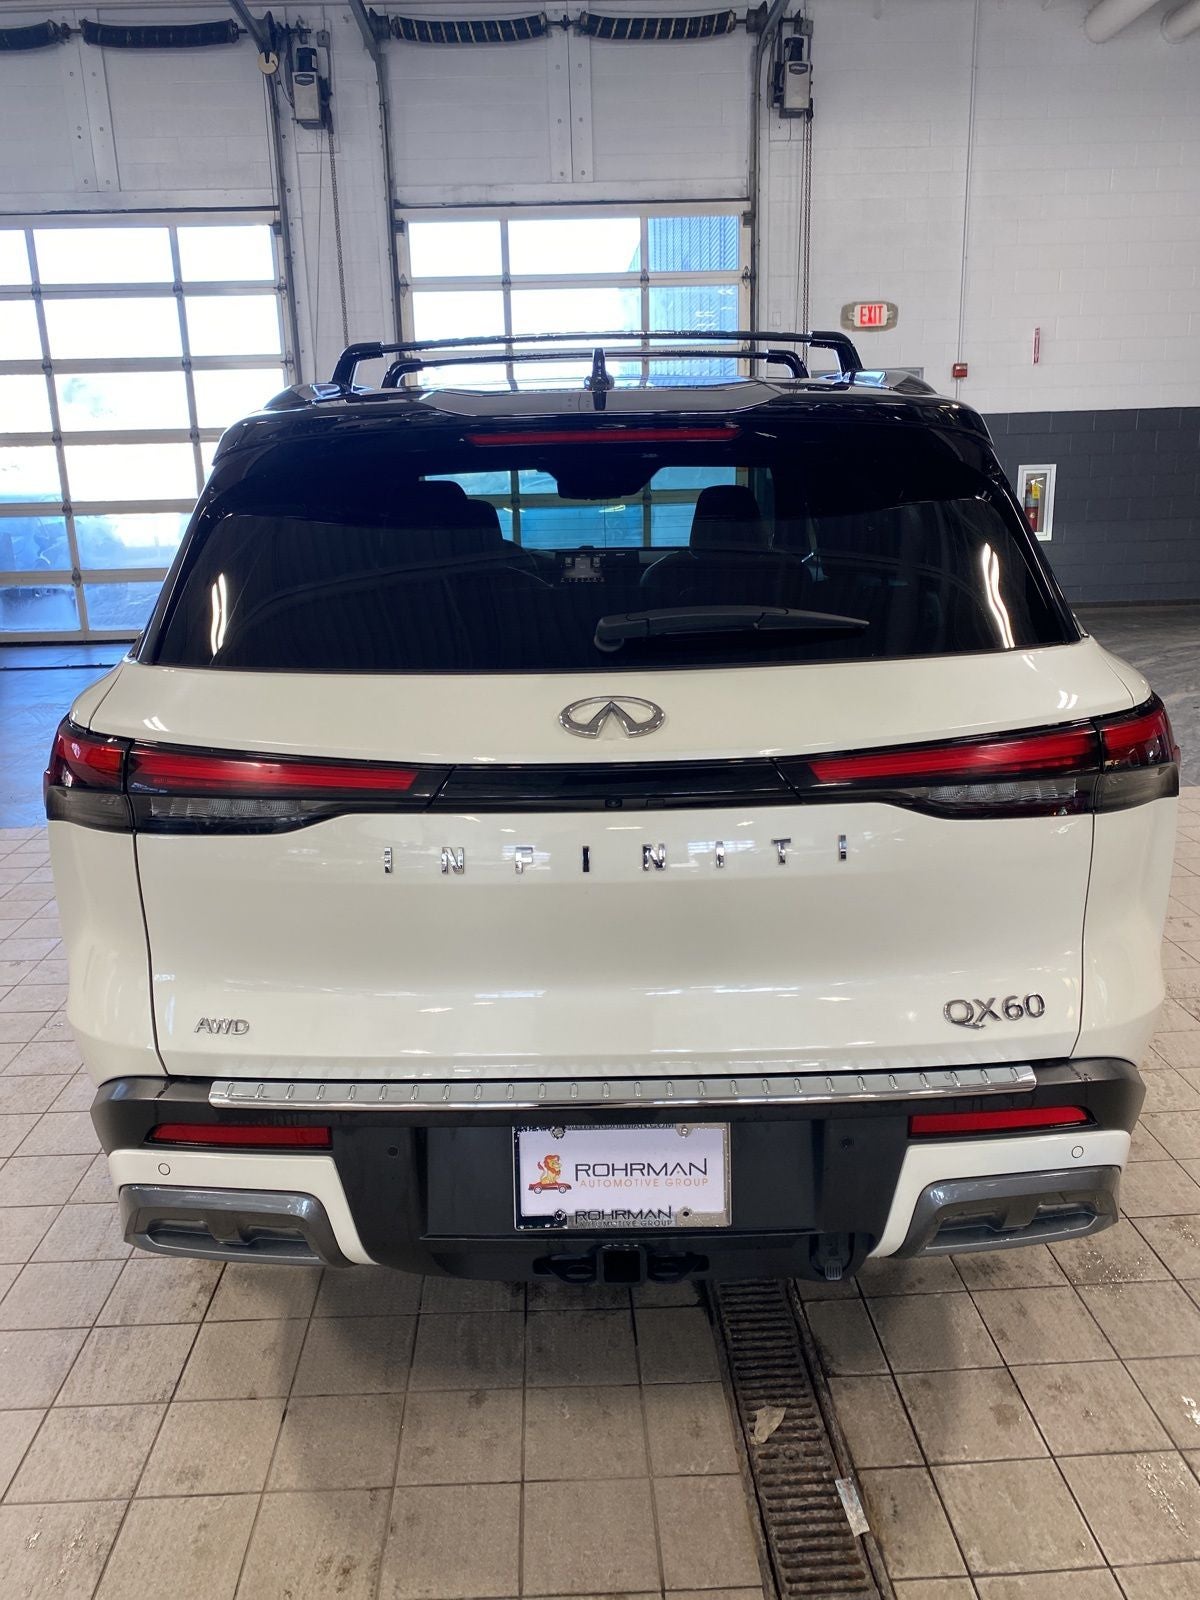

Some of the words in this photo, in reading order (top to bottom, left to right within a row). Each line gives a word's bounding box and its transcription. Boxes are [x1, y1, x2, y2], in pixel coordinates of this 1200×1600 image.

[860, 305, 883, 325] EXIT
[384, 834, 847, 875] INFINITI
[943, 994, 1045, 1029] QX60
[194, 1017, 249, 1035] AWD
[575, 1158, 707, 1181] ROHRMAN
[580, 1179, 660, 1188] AUTOMOTIVE
[664, 1177, 709, 1187] GROUP
[575, 1205, 671, 1224] ROHRMAN
[640, 1219, 672, 1227] GROUP
